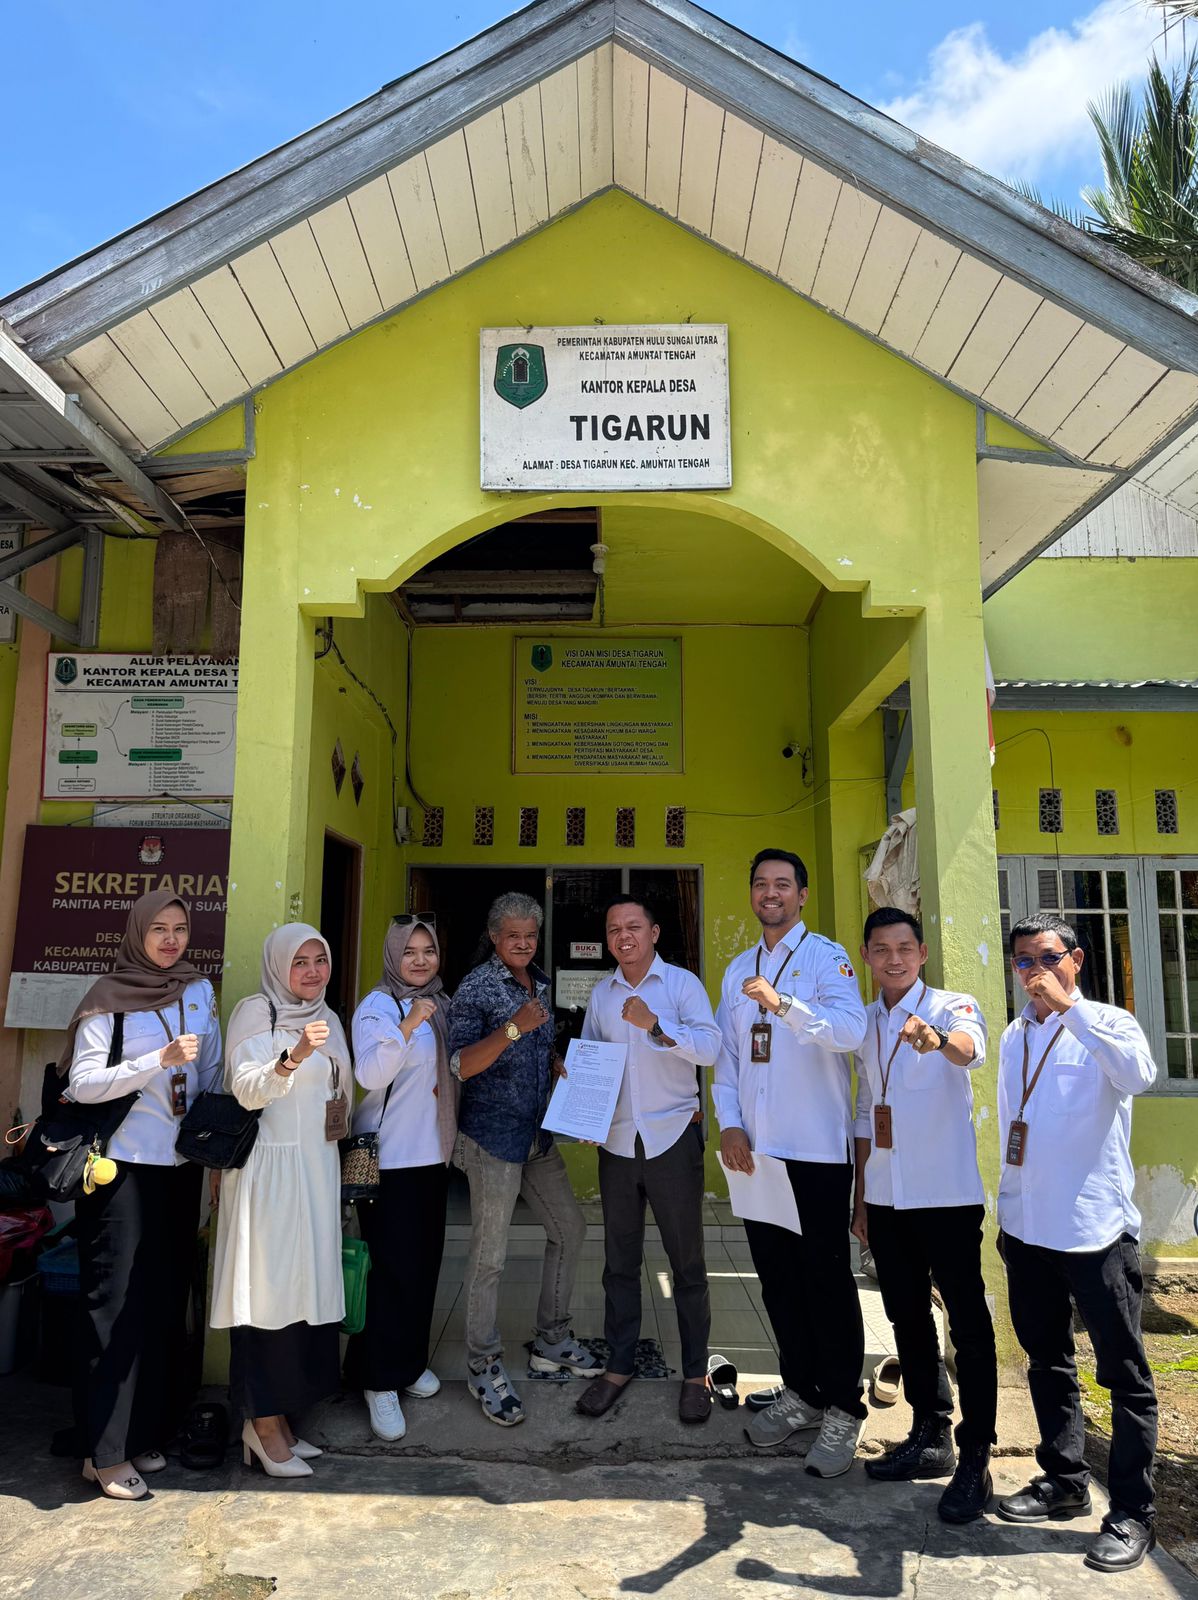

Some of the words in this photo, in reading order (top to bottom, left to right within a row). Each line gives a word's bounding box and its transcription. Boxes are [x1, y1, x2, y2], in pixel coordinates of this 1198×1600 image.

[557, 337, 601, 346] PEMERINTAH
[604, 337, 645, 346] KABUPATEN
[647, 336, 665, 345] HULU
[667, 336, 693, 345] SUNGAI
[696, 336, 718, 345] UTARA
[579, 351, 625, 361] KECAMATAN
[628, 350, 662, 360] AMUNTAI
[664, 350, 696, 360] TENGAH
[581, 380, 623, 394] KANTOR
[626, 380, 666, 393] KEPALA
[669, 379, 696, 393] DESA
[570, 414, 710, 441] TIGARUN
[523, 460, 554, 470] ALAMAT
[561, 460, 581, 469] DESA
[584, 460, 617, 469] TIGARUN
[620, 459, 638, 469] KEC.
[640, 459, 675, 469] AMUNTAI
[678, 458, 710, 468] TENGAH
[130, 657, 164, 666] ALUR
[83, 668, 136, 676] KANTOR
[140, 668, 191, 677] KEPALA
[194, 668, 228, 677] DESA
[86, 679, 165, 687] KECAMATAN
[170, 679, 228, 687] AMUNTAI
[55, 872, 229, 896] SEKRETARIA
[52, 899, 100, 909] PANITIA
[33, 961, 109, 972] KABUPATEN
